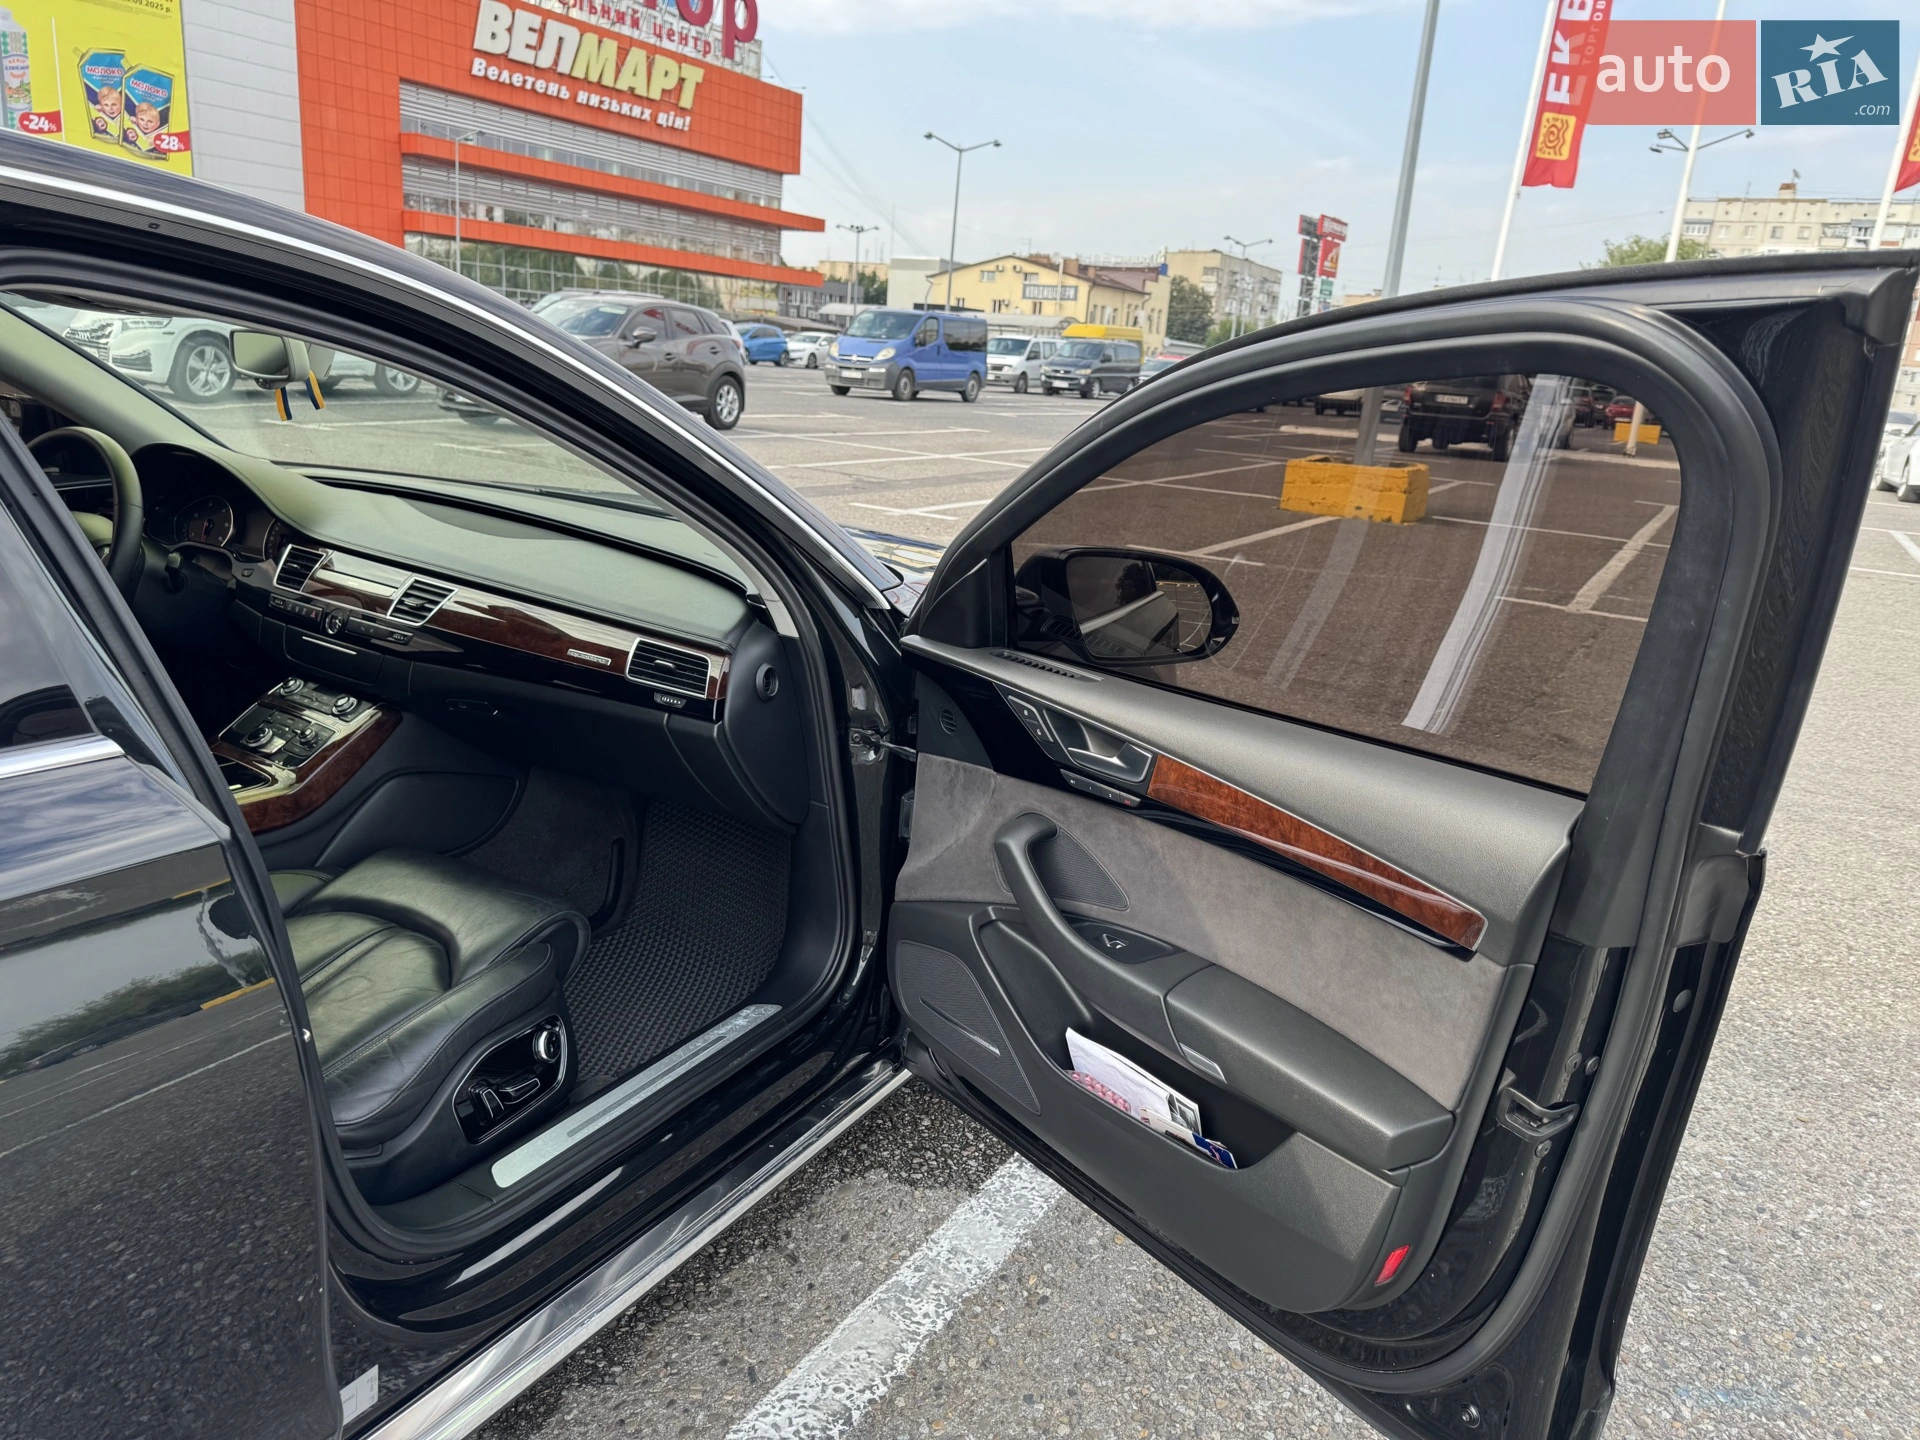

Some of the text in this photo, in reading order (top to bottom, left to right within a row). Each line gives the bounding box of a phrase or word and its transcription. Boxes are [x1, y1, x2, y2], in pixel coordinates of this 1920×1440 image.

[653, 22, 712, 58] центр
[473, 0, 705, 110] ВЕЛМАРТ
[86, 65, 124, 76] МОЛОКО
[130, 78, 168, 98] МОЛОКО
[471, 57, 691, 131] Велетень низьких цін!
[23, 114, 57, 131] -24%
[155, 134, 185, 151] -28%
